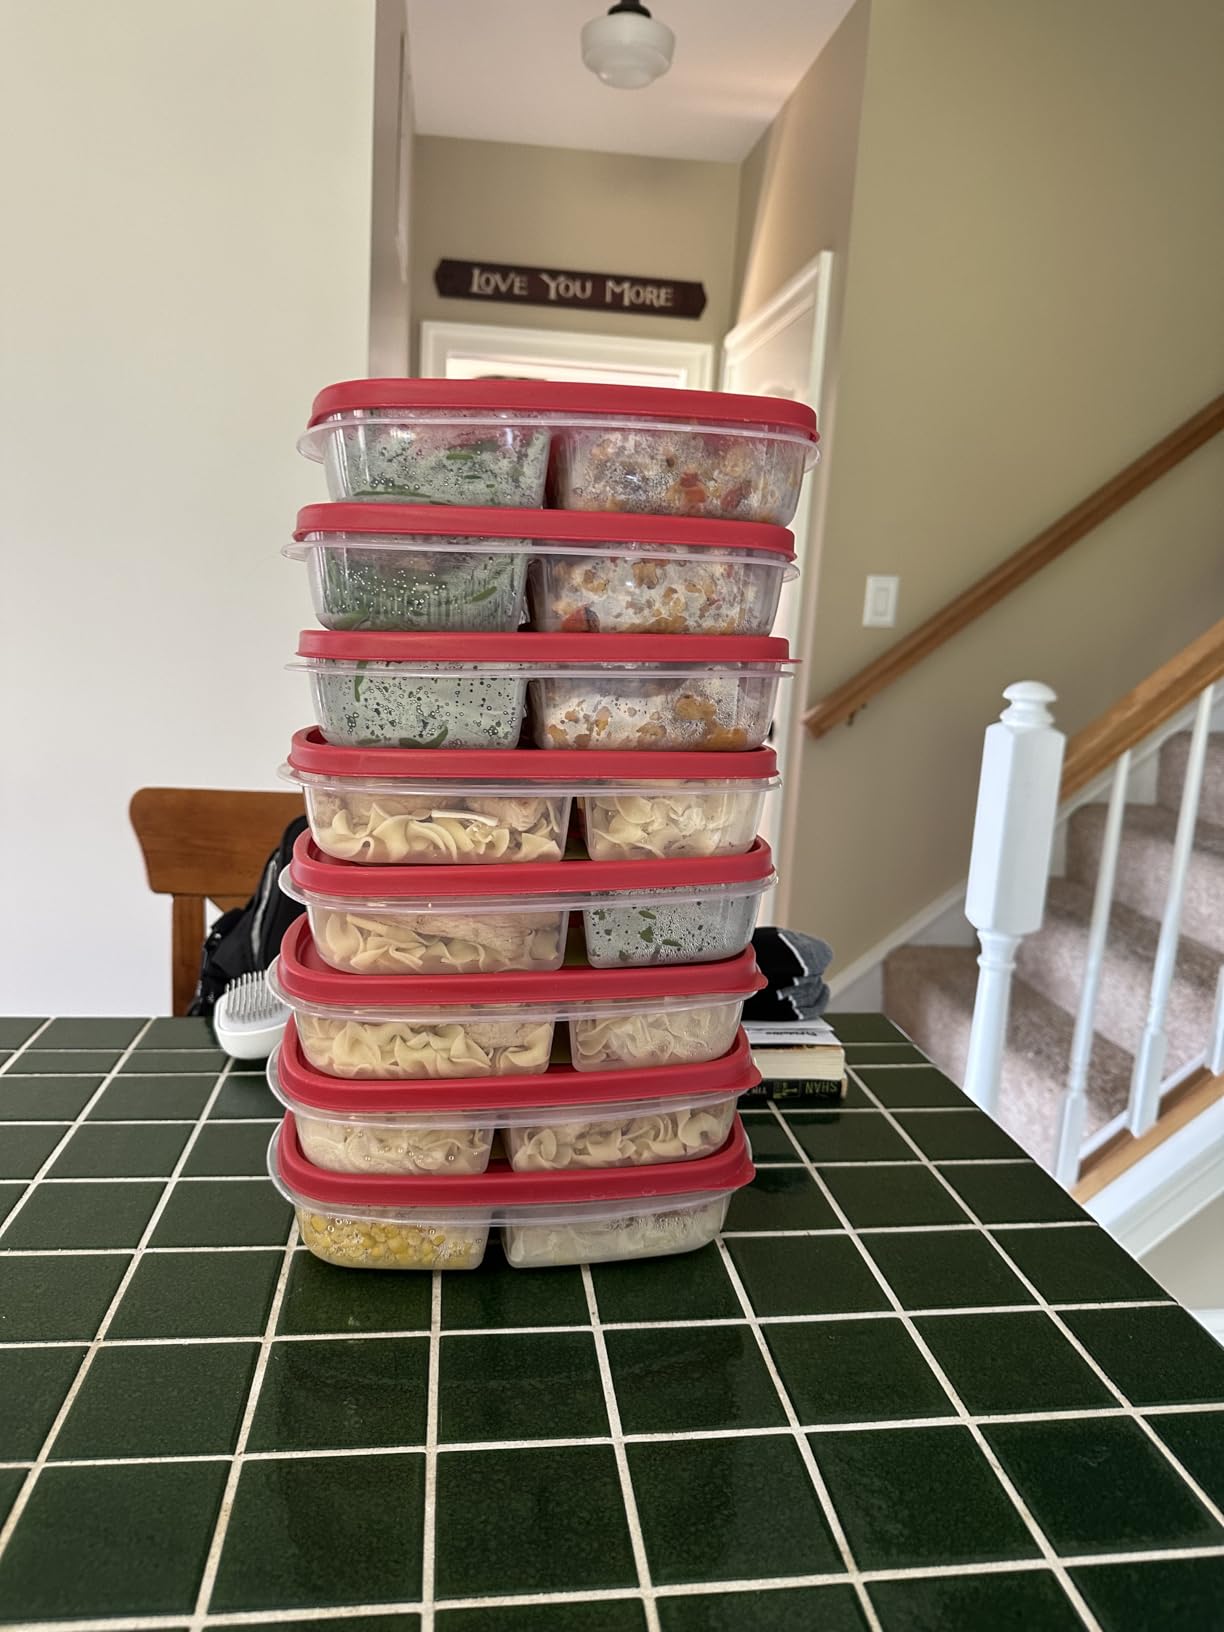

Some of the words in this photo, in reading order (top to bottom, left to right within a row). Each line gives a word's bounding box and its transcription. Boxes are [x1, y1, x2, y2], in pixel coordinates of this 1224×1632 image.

[470, 268, 528, 295] LOVE
[540, 273, 592, 299] YOU
[605, 280, 674, 307] MORE
